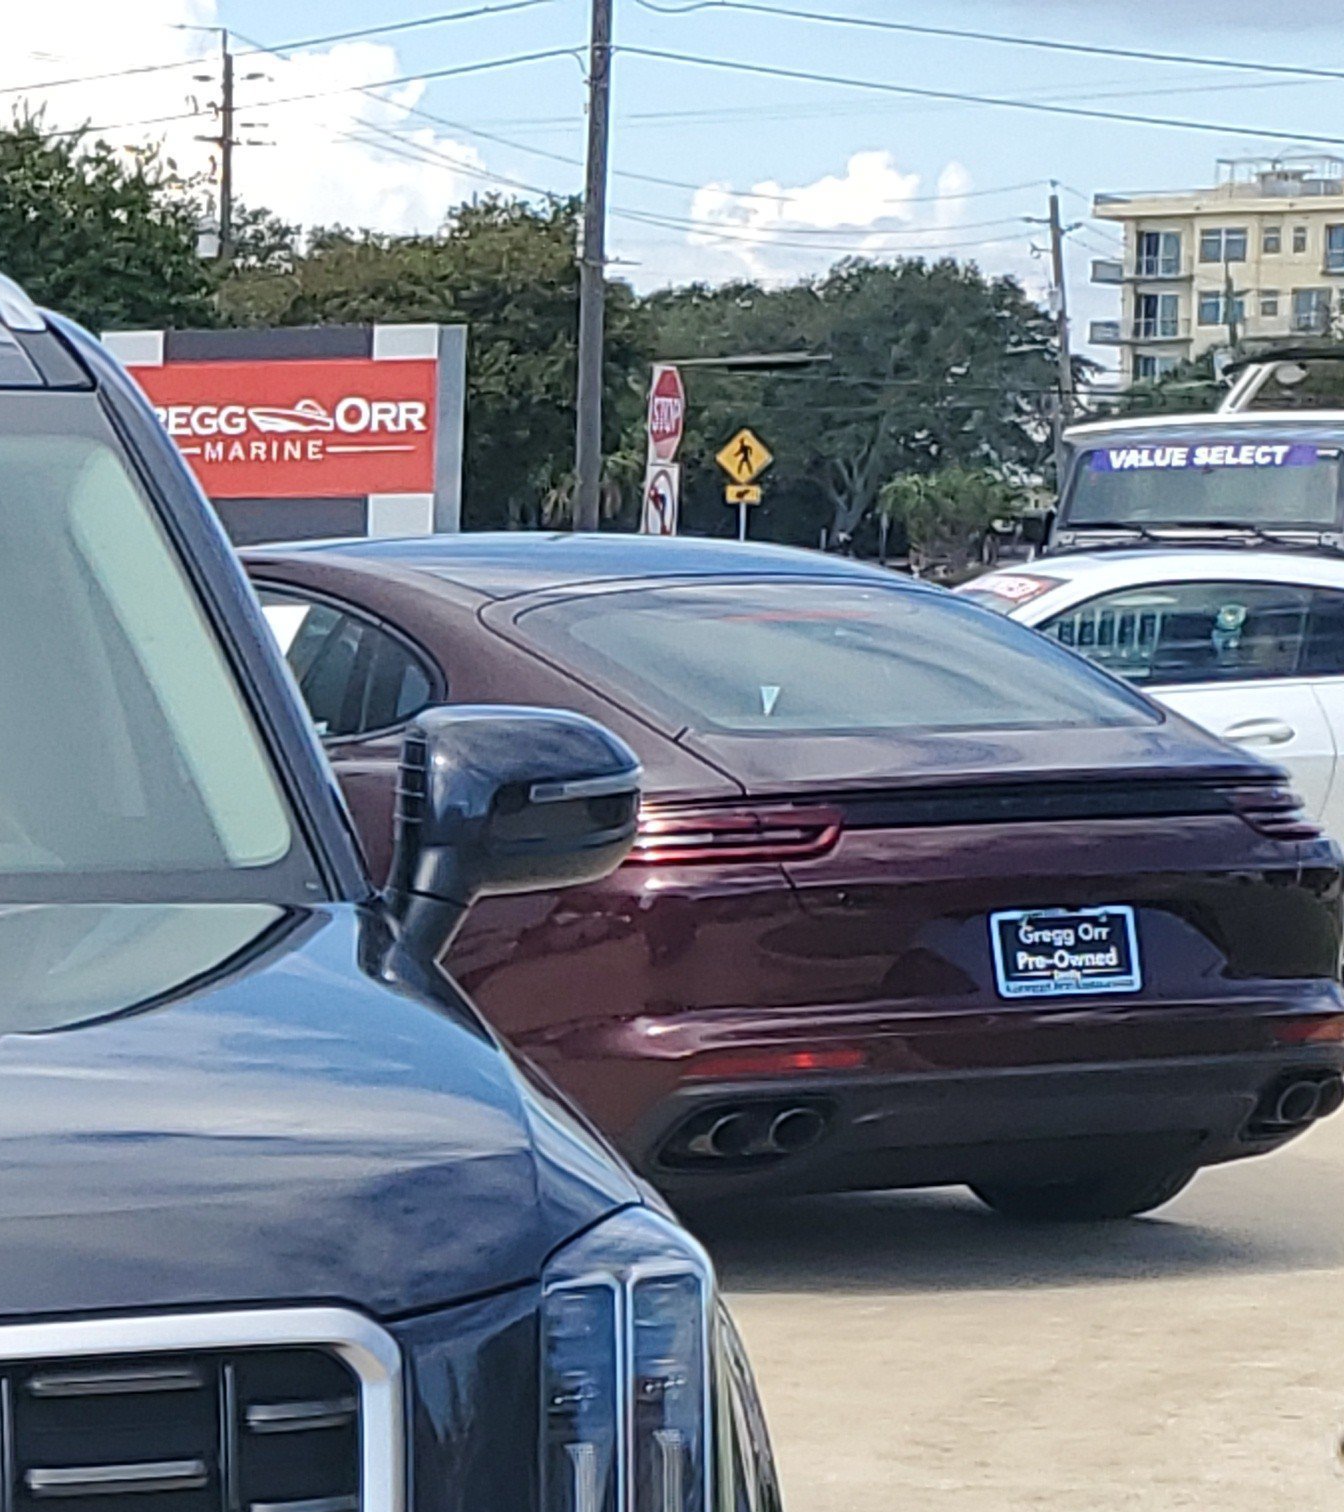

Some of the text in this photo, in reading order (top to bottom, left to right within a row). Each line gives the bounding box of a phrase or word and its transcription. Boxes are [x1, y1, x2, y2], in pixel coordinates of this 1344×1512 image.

[335, 397, 427, 433] ORR
[652, 397, 681, 432] STOP
[204, 439, 324, 462] MARINE
[1109, 445, 1290, 469] VALUE SELECT
[1018, 922, 1111, 947] Gregg Orr
[1015, 945, 1119, 971] Pre-Owned
